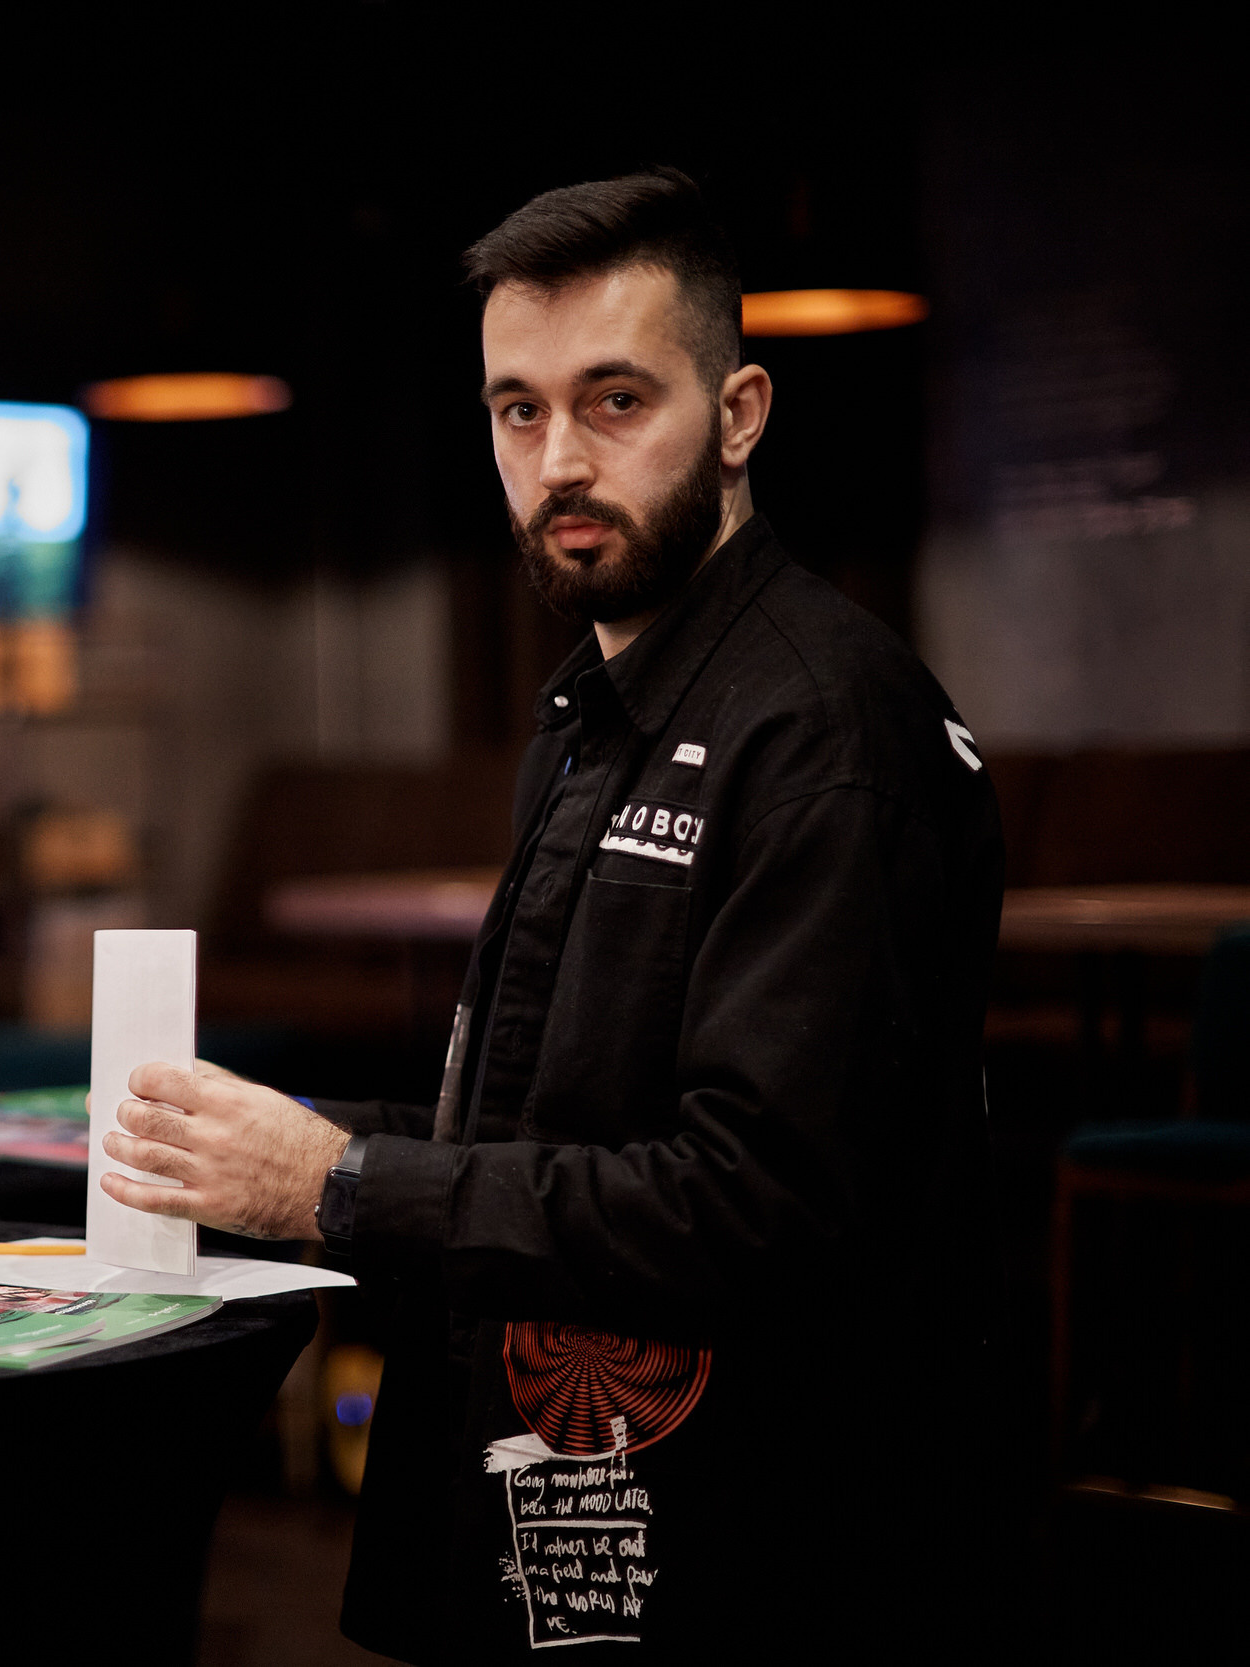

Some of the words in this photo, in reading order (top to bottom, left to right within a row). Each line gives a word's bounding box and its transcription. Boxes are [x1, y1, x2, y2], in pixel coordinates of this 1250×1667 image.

[520, 1498, 546, 1515] been
[552, 1496, 573, 1515] the
[544, 1536, 588, 1557] rather
[593, 1536, 613, 1555] be
[619, 1530, 646, 1557] out
[551, 1558, 584, 1583] field
[590, 1558, 622, 1583] and
[534, 1585, 558, 1605] the
